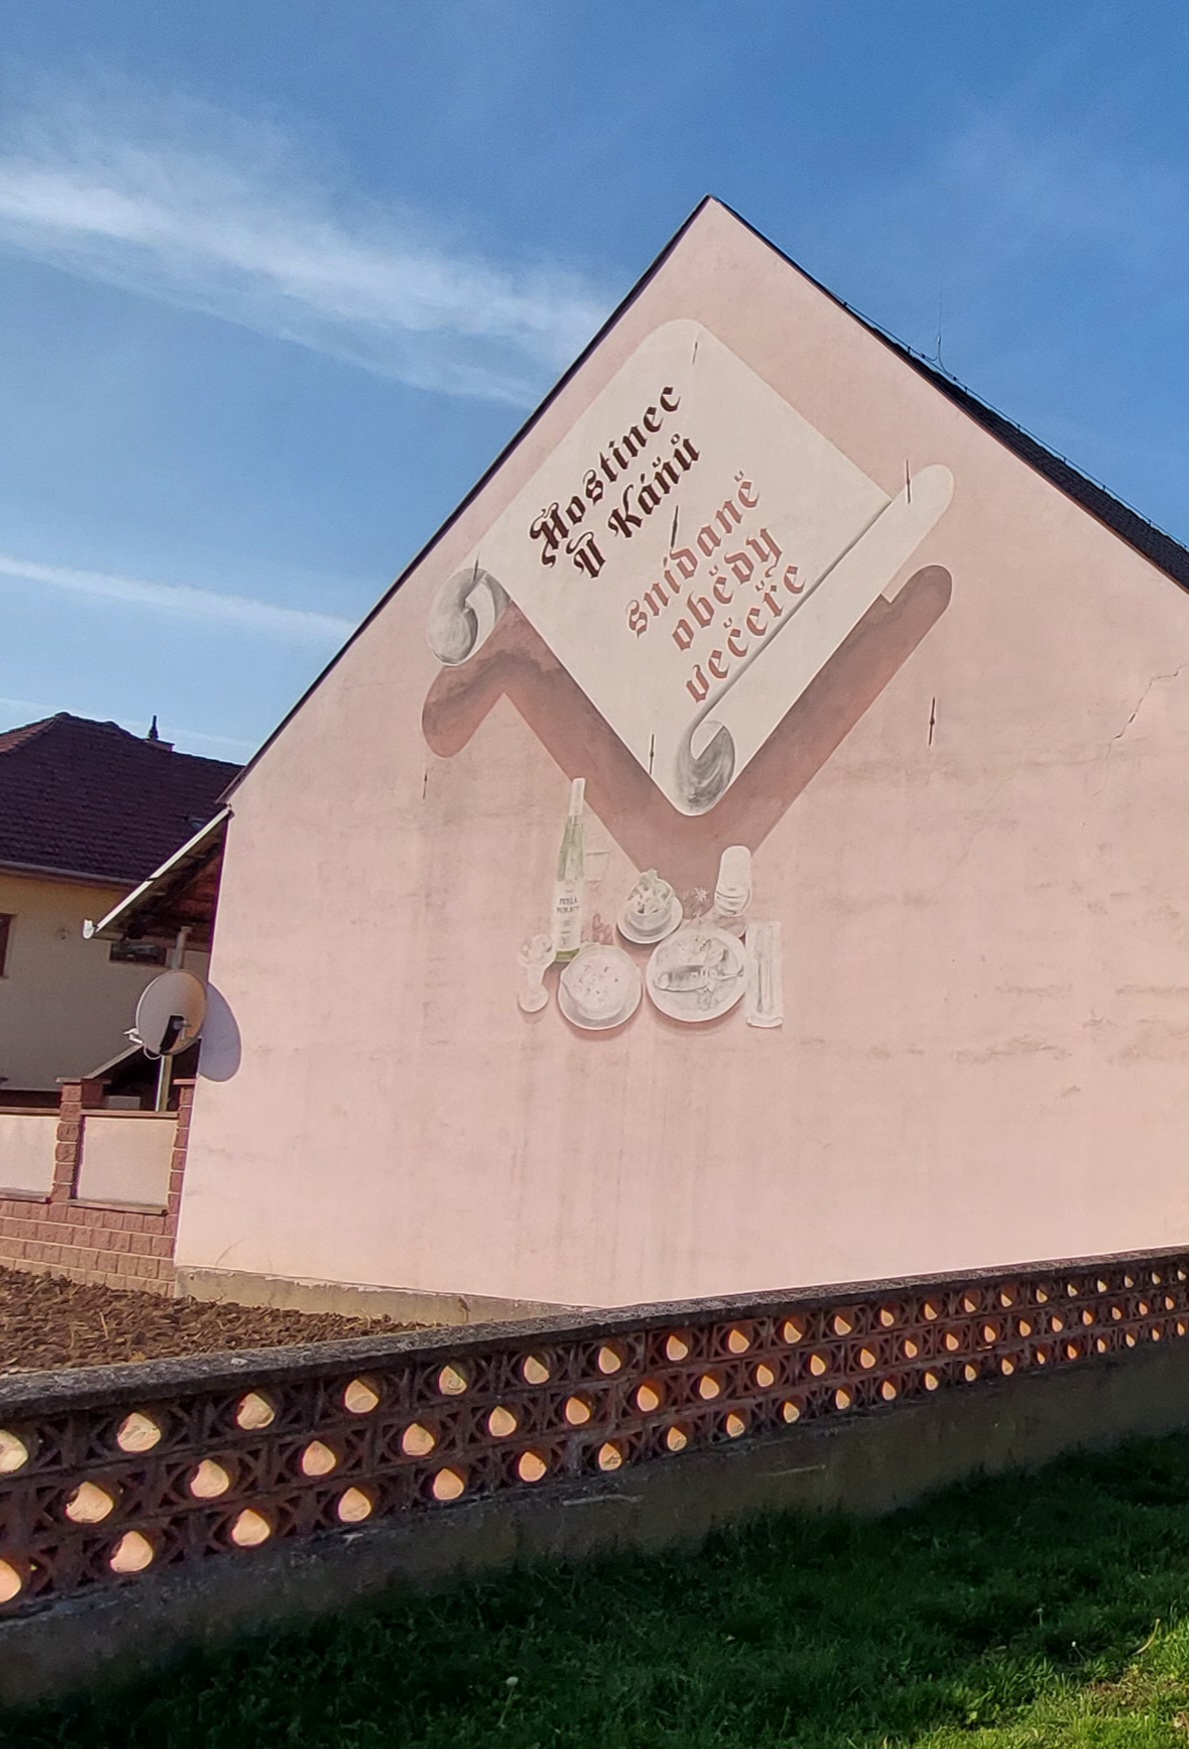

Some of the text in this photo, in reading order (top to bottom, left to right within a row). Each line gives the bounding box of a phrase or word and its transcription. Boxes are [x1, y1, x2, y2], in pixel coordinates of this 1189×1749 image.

[529, 386, 681, 568] Hostinec
[565, 531, 606, 579] U
[671, 528, 782, 651] obědy
[685, 564, 806, 703] večeře
